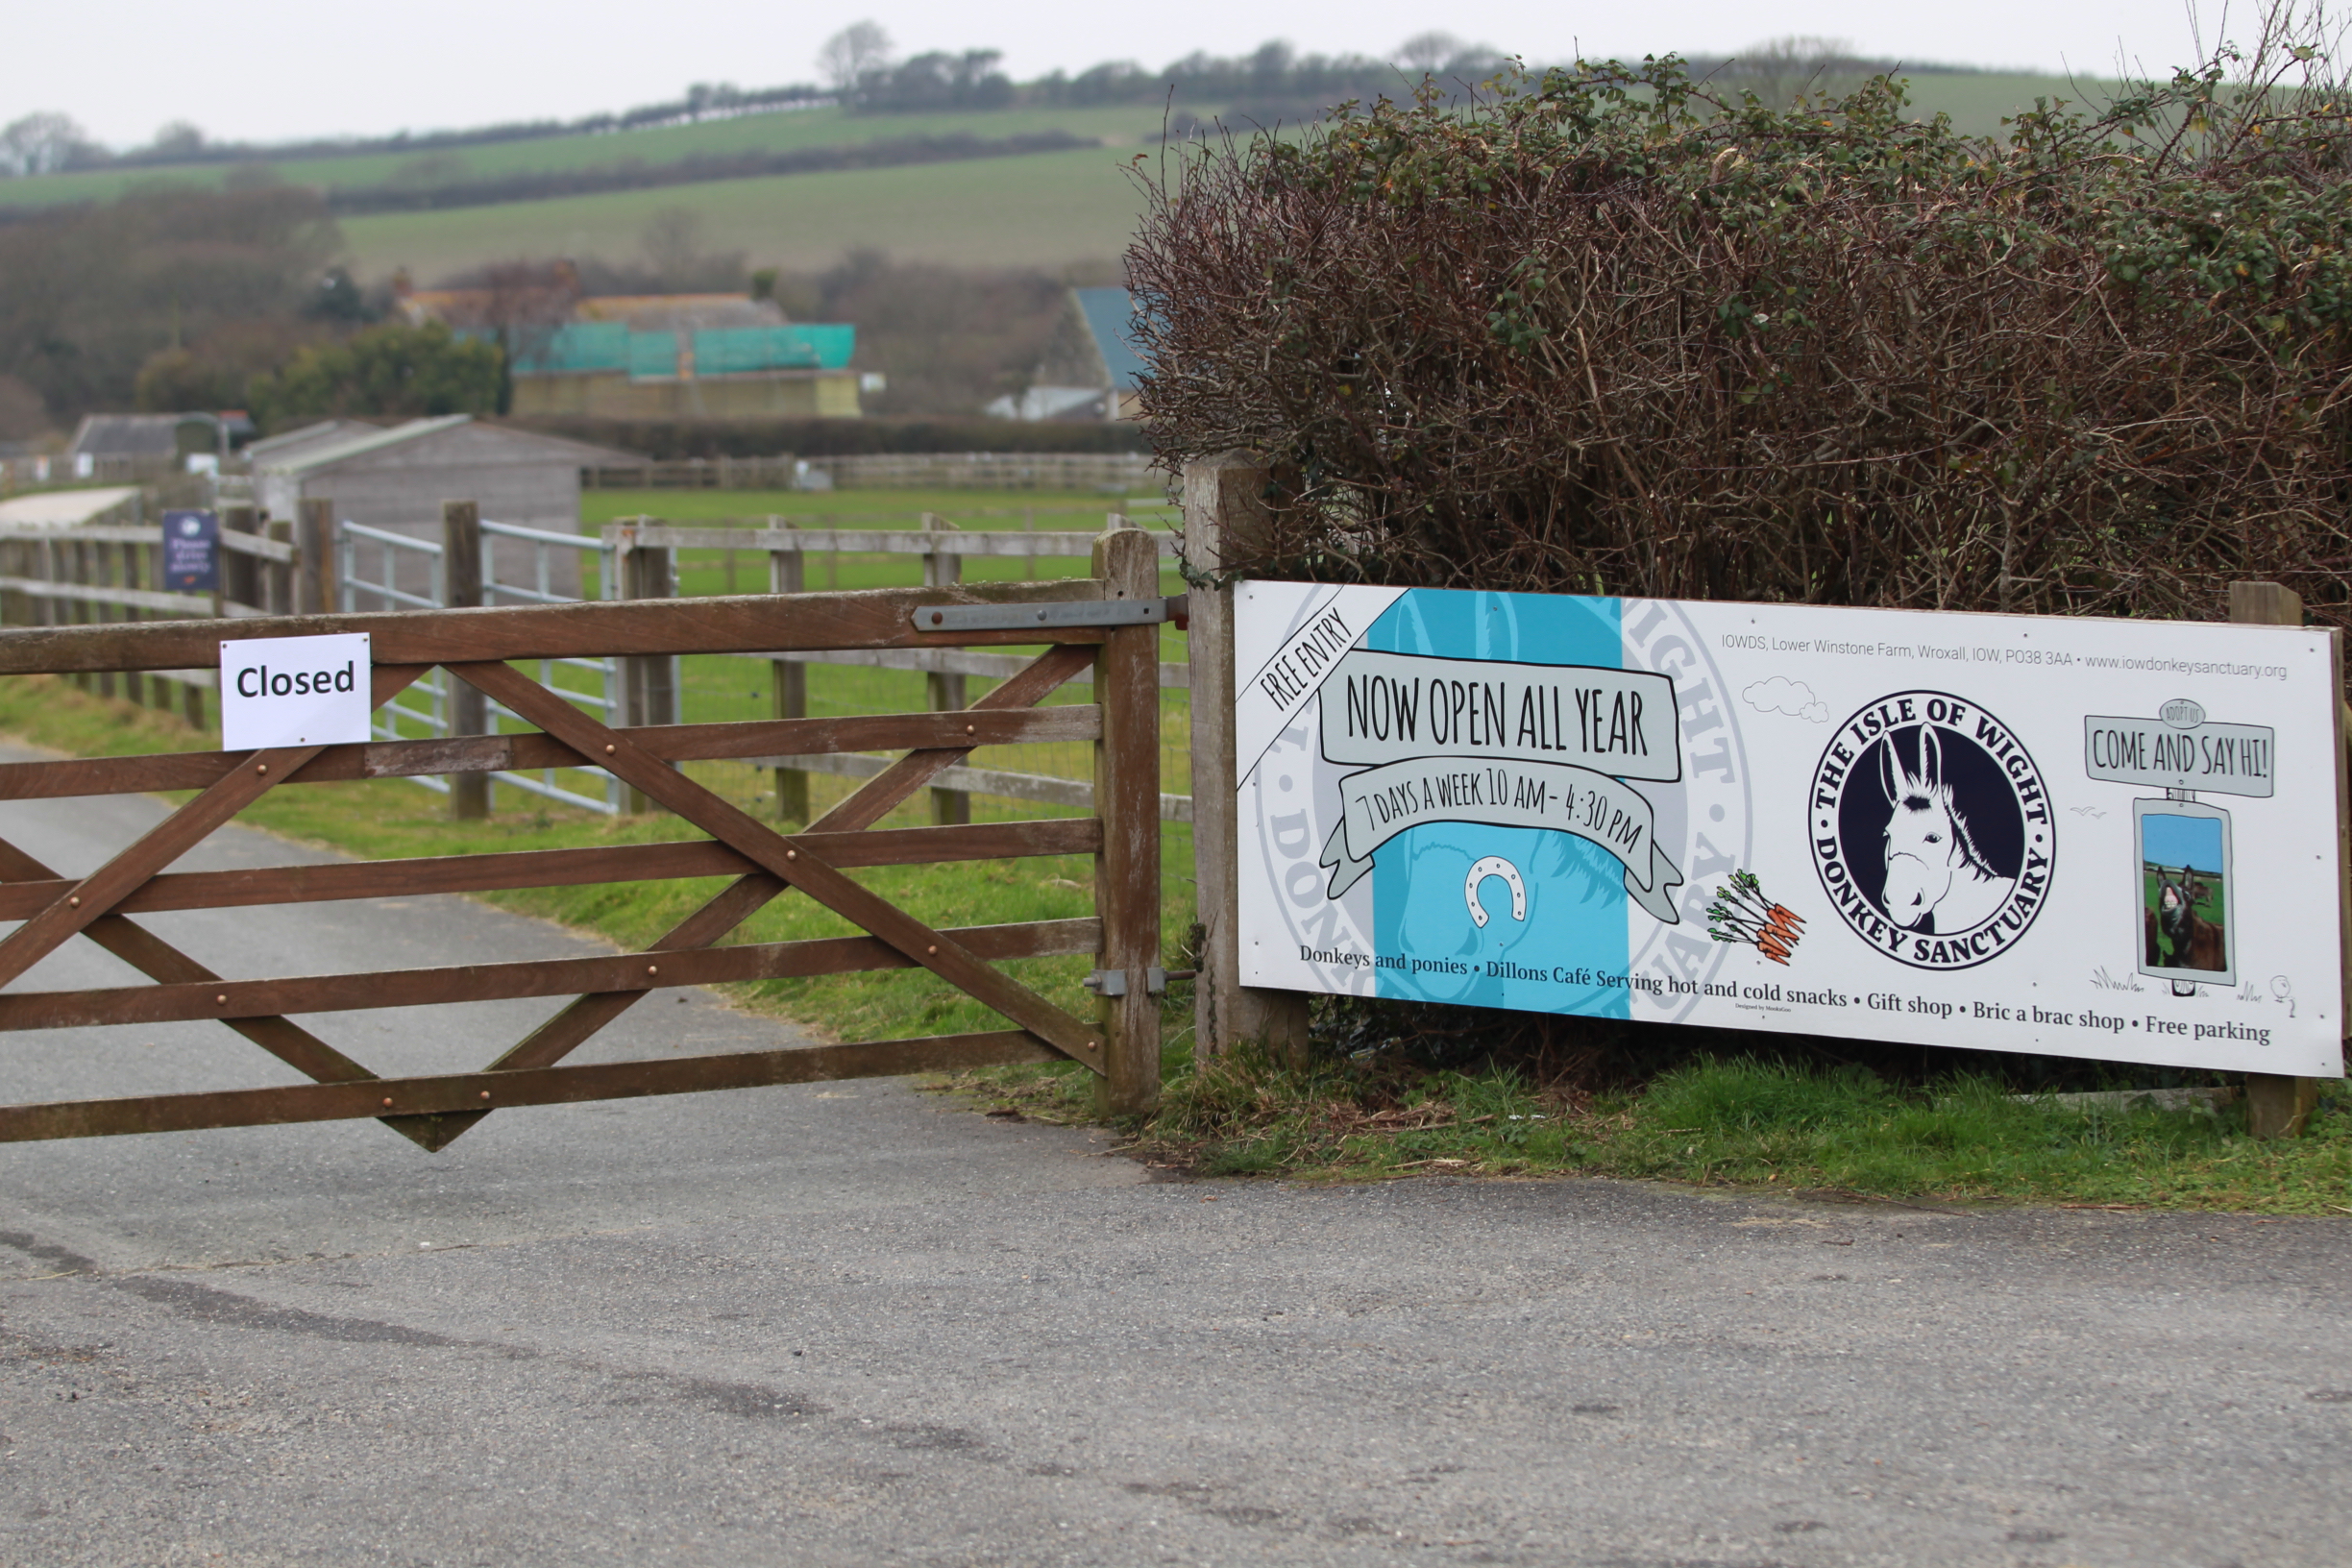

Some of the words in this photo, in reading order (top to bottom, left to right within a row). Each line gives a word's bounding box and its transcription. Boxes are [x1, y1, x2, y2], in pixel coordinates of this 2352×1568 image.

[237, 660, 355, 698] Closed
[1260, 655, 1309, 712] FREE
[1294, 606, 1352, 677] ENTRY
[1722, 634, 1769, 652] IOWDS,
[1772, 637, 1811, 652] Lower
[1814, 639, 1874, 655] Winstone
[1877, 643, 1915, 660] Farm,
[1918, 645, 1969, 662] Wroxall,
[1972, 648, 2002, 664] IOW,
[2006, 649, 2042, 665] PO38
[2046, 651, 2073, 666] 3AA
[2085, 655, 2288, 681] www.iowdonkeysanctuary.org
[1347, 674, 1420, 743] NOW
[1430, 678, 1506, 748] OPEN
[1517, 685, 1568, 752] ALL
[1575, 687, 1648, 757] YEAR
[2094, 729, 2147, 771] COME
[2153, 733, 2195, 772] AND
[2201, 735, 2235, 776] SAY
[2241, 738, 2268, 779] HI!
[2166, 705, 2188, 721] ADOPT
[2190, 707, 2200, 723] US
[1816, 741, 1855, 811] THE
[1850, 698, 1917, 746] ISLE
[1926, 698, 1967, 726] OF
[1974, 716, 2048, 826] WIGHT
[1355, 796, 1375, 832] 7
[1374, 780, 1419, 824] DAYS
[1423, 777, 1435, 811] A
[1435, 772, 1483, 808] WEEK
[1486, 768, 1508, 806] 10
[1566, 783, 1607, 832] 4:30
[1607, 809, 1643, 854] PM
[1816, 836, 1908, 953] DONKEY
[1913, 846, 2048, 964] SANCTUARY
[1300, 944, 1370, 969] Donkeys
[1375, 953, 1407, 969] and
[1411, 957, 1468, 975] ponies
[1485, 961, 1548, 982] Dillons
[1553, 967, 1591, 986] Café
[1596, 970, 1663, 996] Serving
[1668, 975, 1699, 995] hot
[1703, 980, 1737, 998] and
[1743, 983, 1781, 1001] cold
[1787, 988, 1848, 1008] snacks
[1868, 992, 1902, 1012] Gift
[1907, 995, 1952, 1018] shop
[1973, 1001, 2010, 1020] Bric
[2017, 1008, 2027, 1022] a
[2032, 1005, 2073, 1026] brac
[2079, 1009, 2125, 1034] shop
[2145, 1016, 2188, 1036] Free
[2193, 1020, 2271, 1046] parking
